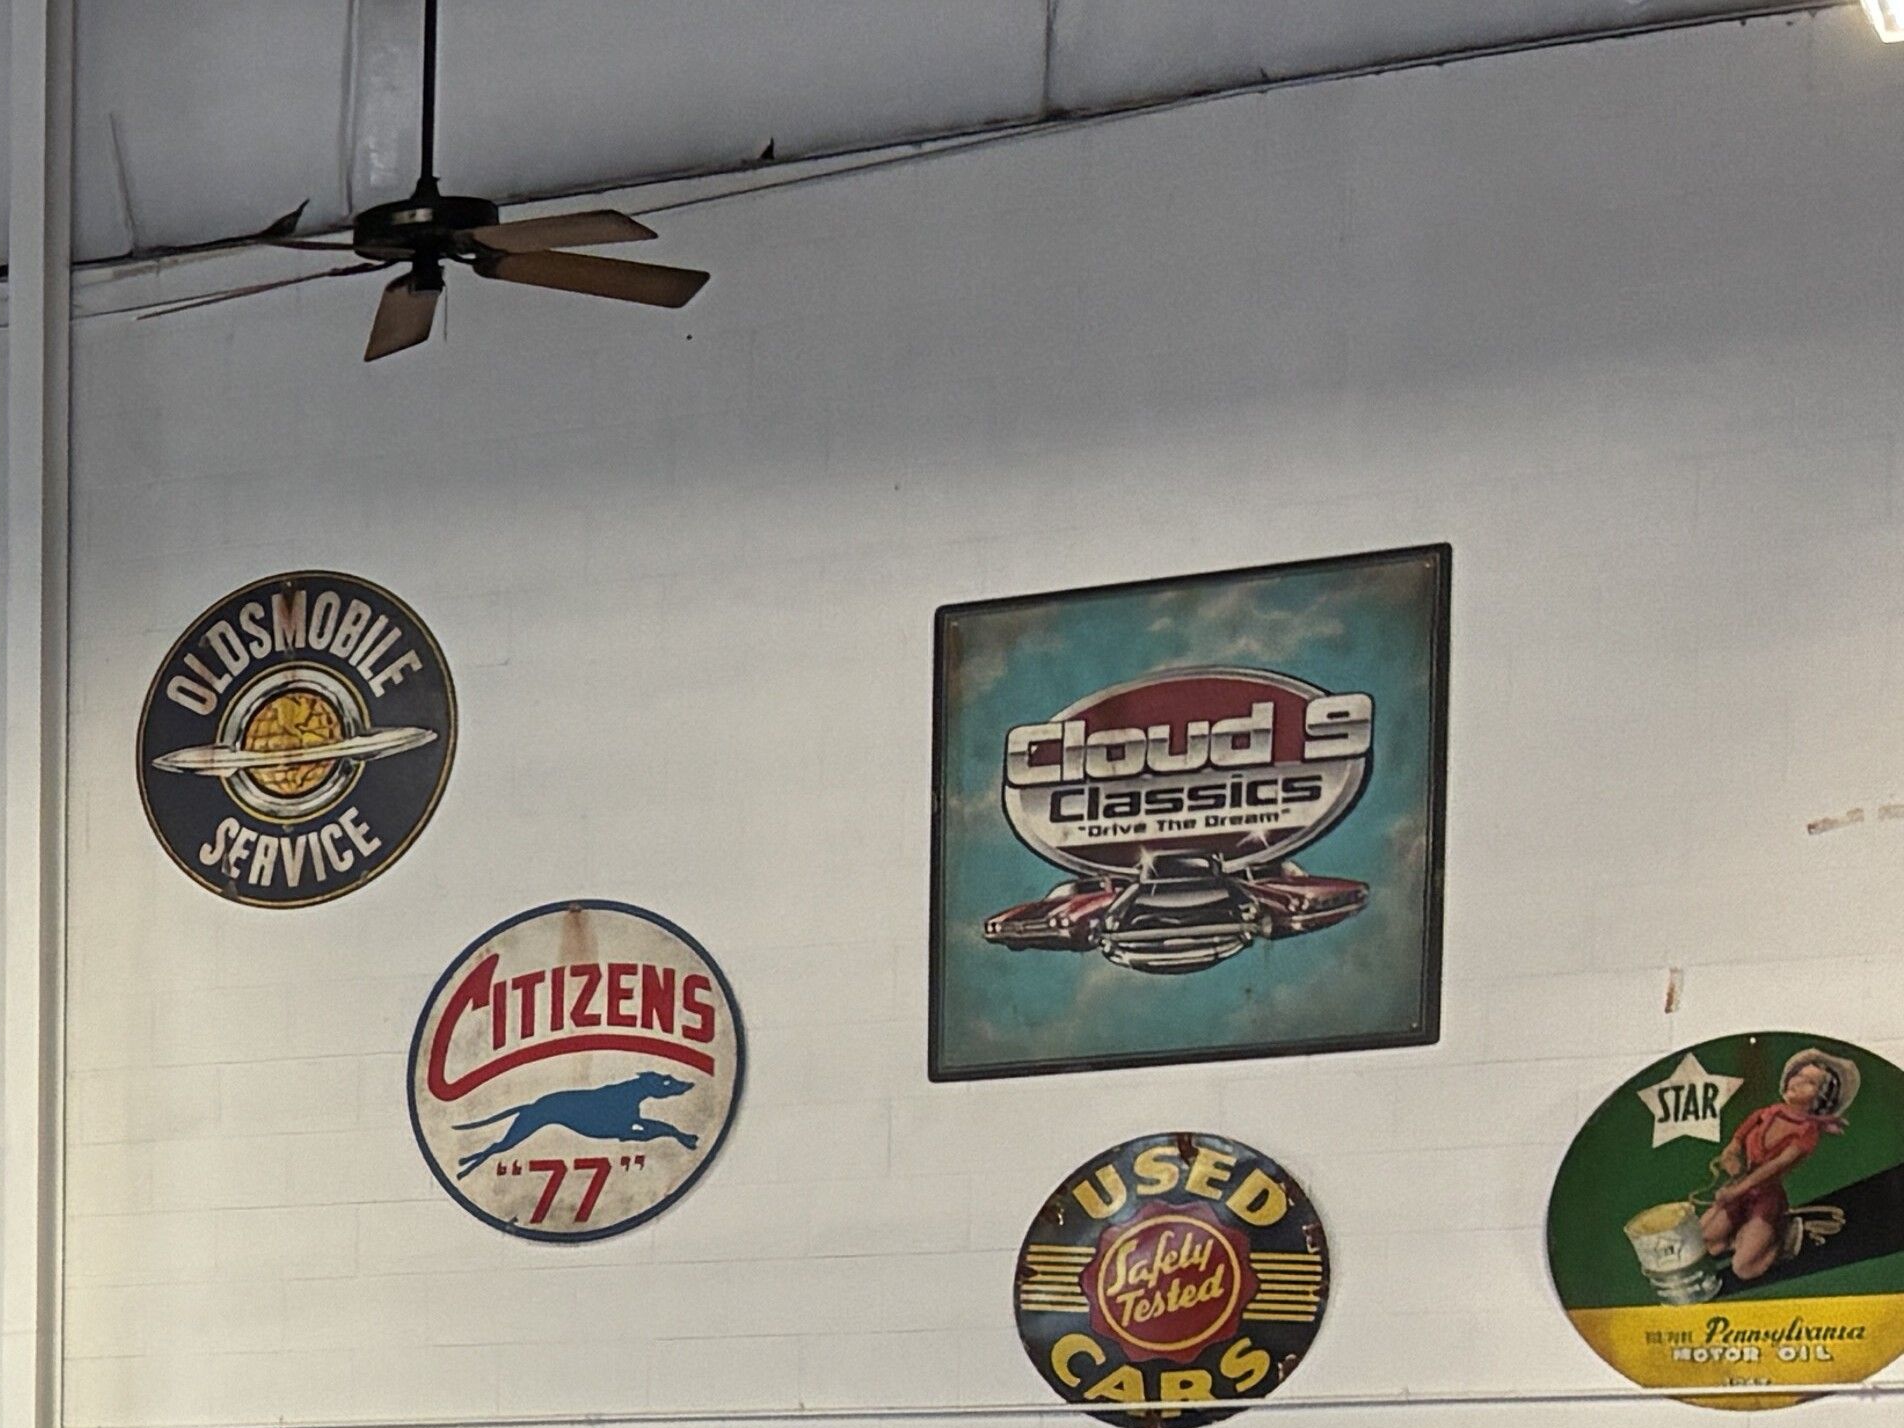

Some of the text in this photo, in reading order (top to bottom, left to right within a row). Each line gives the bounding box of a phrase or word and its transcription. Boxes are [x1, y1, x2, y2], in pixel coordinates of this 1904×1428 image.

[166, 590, 423, 716] OLDSMOBILE
[1006, 691, 1375, 787] Cloud 9
[1049, 773, 1323, 823] Classics
[1155, 817, 1198, 833] The
[199, 807, 382, 888] SERVICE
[427, 953, 716, 1102] CITIZENS
[1655, 1081, 1721, 1126] STAR
[1072, 1146, 1288, 1227] USED
[1106, 1230, 1214, 1297] Safety
[1116, 1264, 1226, 1328] Tested
[1671, 1345, 1834, 1363] MOTOR OIL
[1704, 1316, 1866, 1347] Pennsylvania
[1051, 1333, 1271, 1418] CARS
